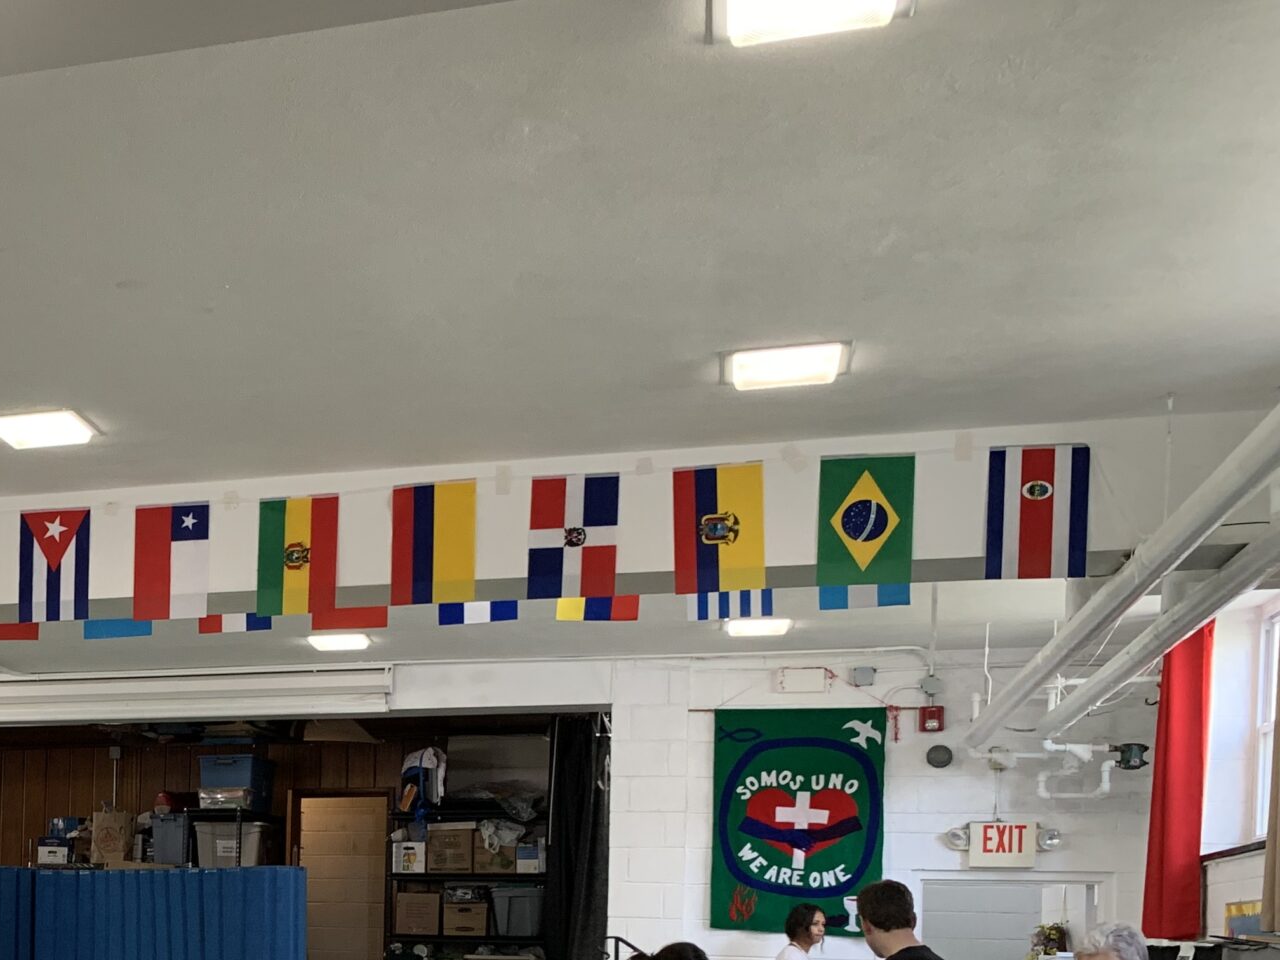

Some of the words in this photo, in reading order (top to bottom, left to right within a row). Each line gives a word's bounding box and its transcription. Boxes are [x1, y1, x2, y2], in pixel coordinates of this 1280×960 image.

[736, 770, 804, 800] SOMOS
[811, 773, 859, 794] UNO
[983, 825, 1027, 853] EXIT
[737, 842, 768, 873] WE
[764, 865, 804, 886] ARE
[808, 864, 851, 888] ONE
